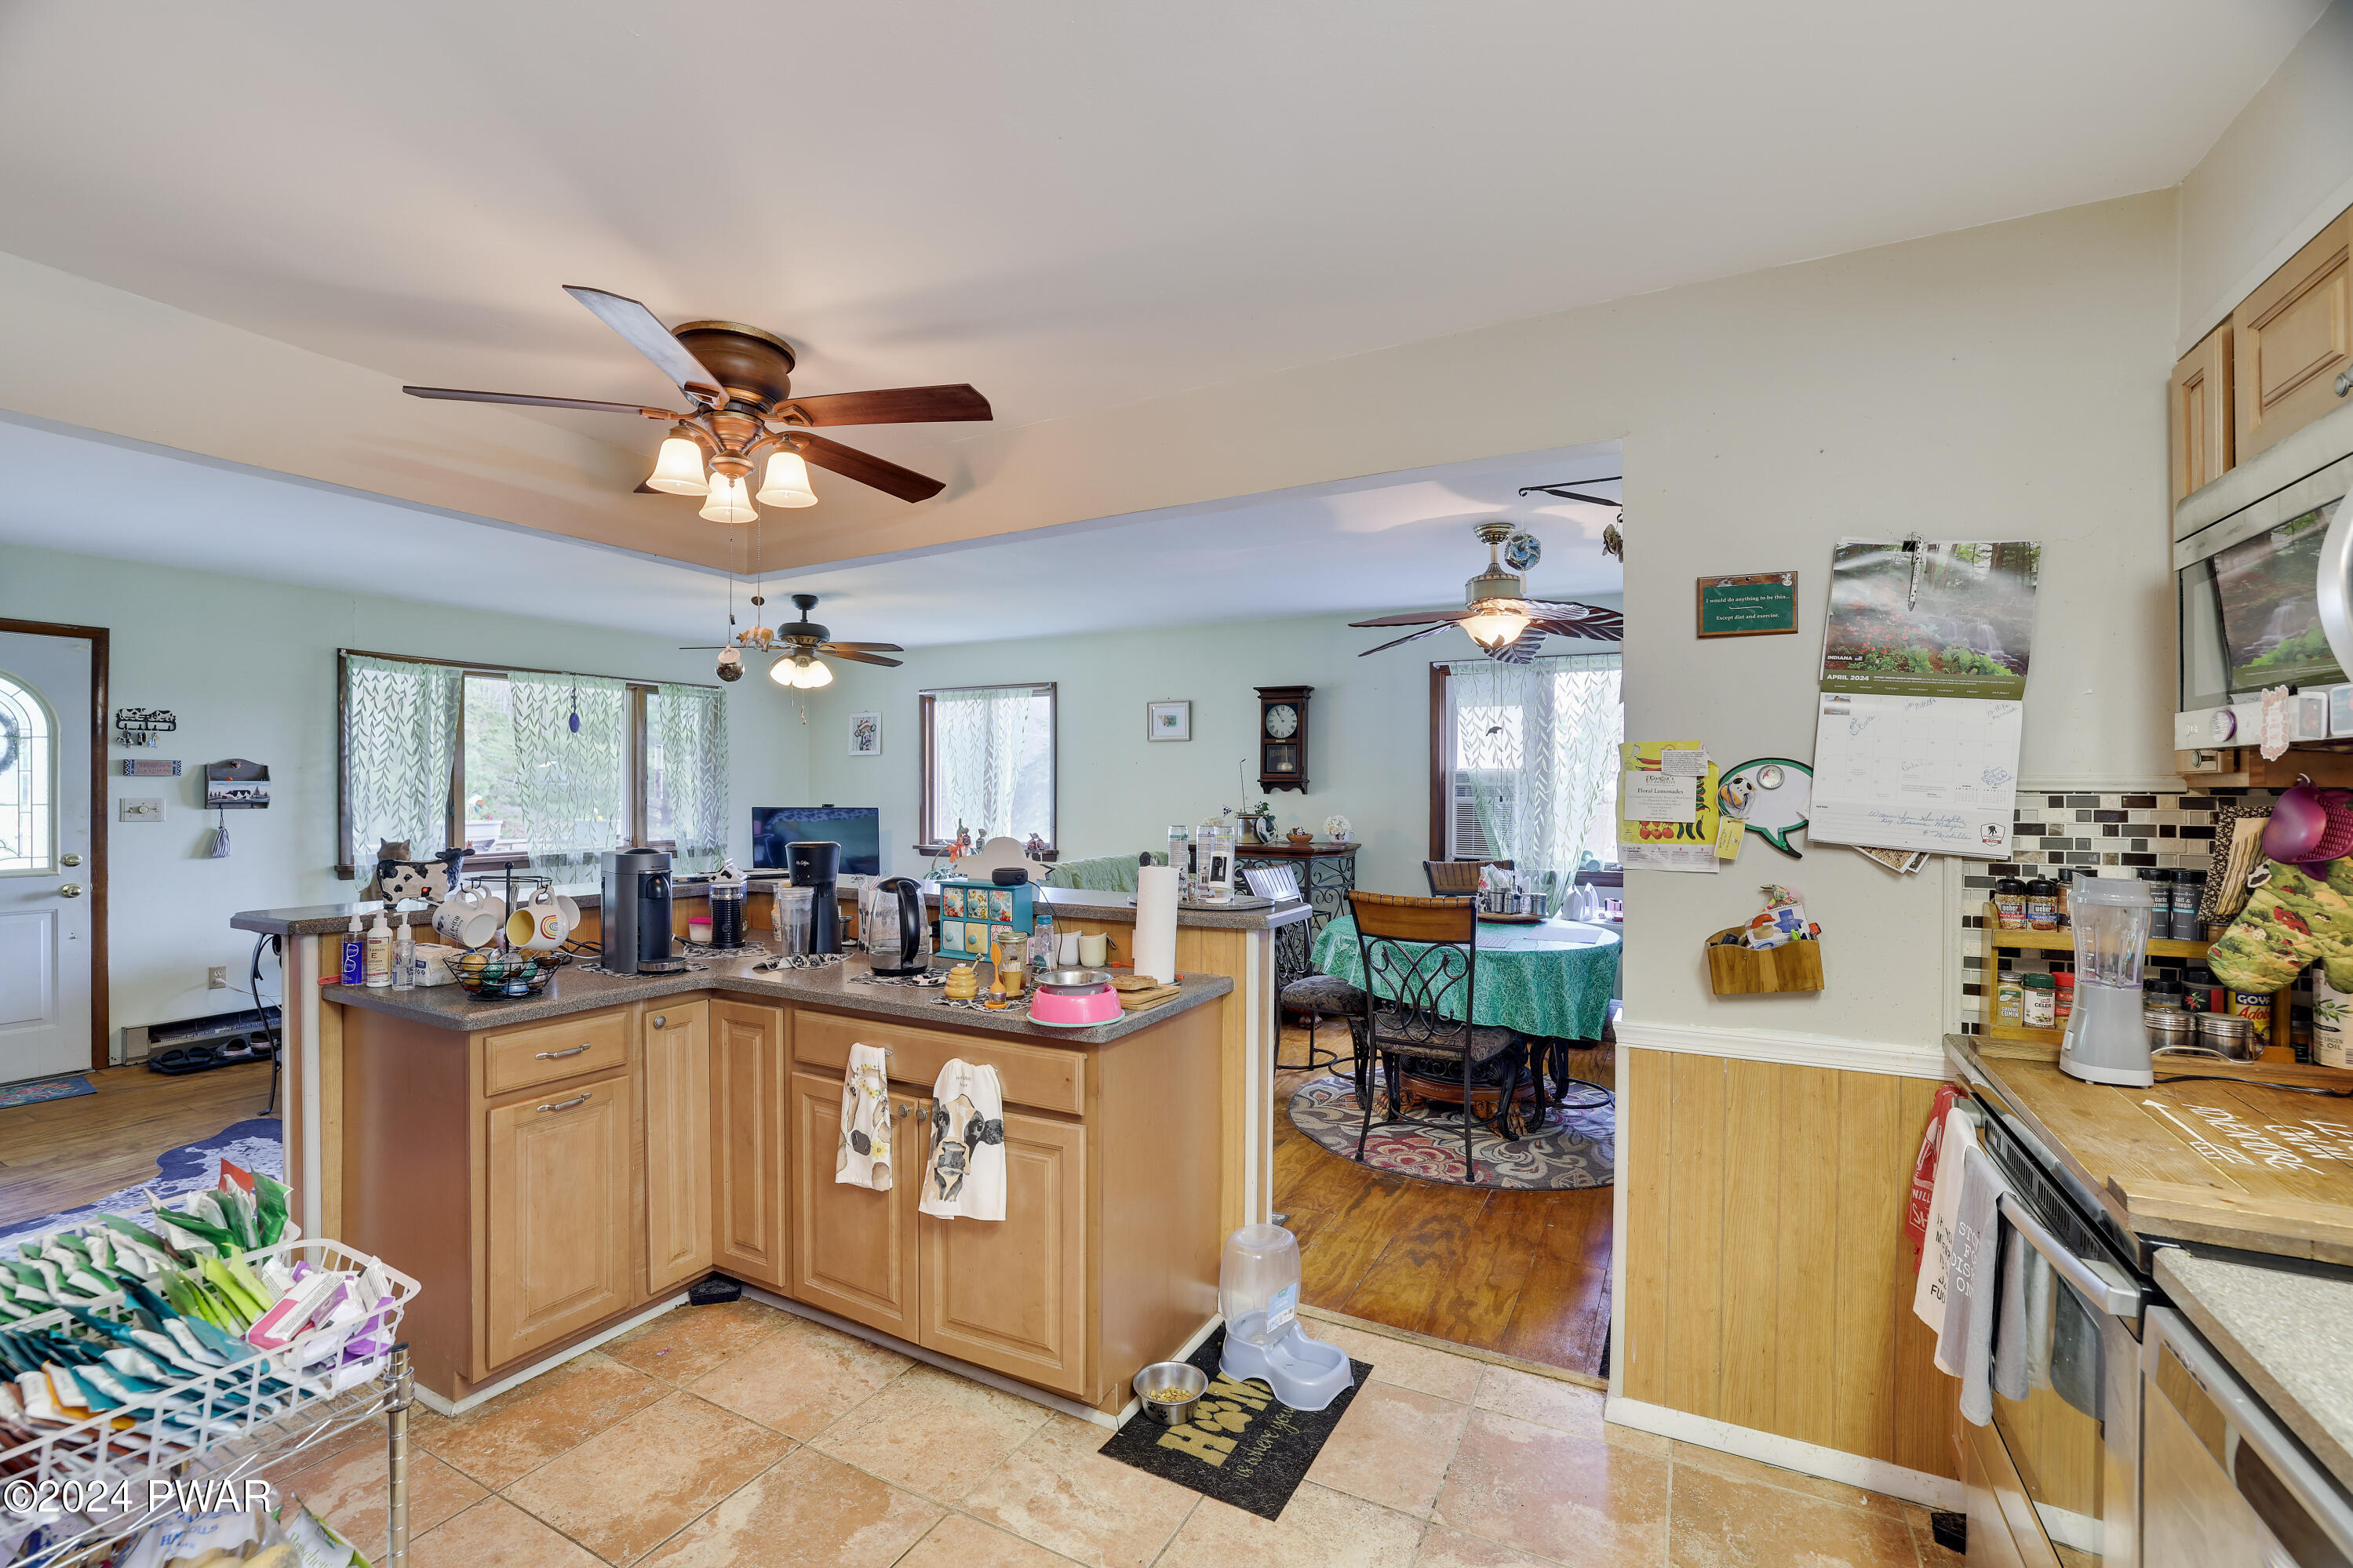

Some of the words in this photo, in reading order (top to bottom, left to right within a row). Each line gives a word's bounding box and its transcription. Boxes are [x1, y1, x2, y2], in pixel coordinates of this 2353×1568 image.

[2237, 1006, 2271, 1020] Adob
[2181, 1103, 2326, 1176] ADVENTURE
[1930, 1284, 1946, 1304] FUC
